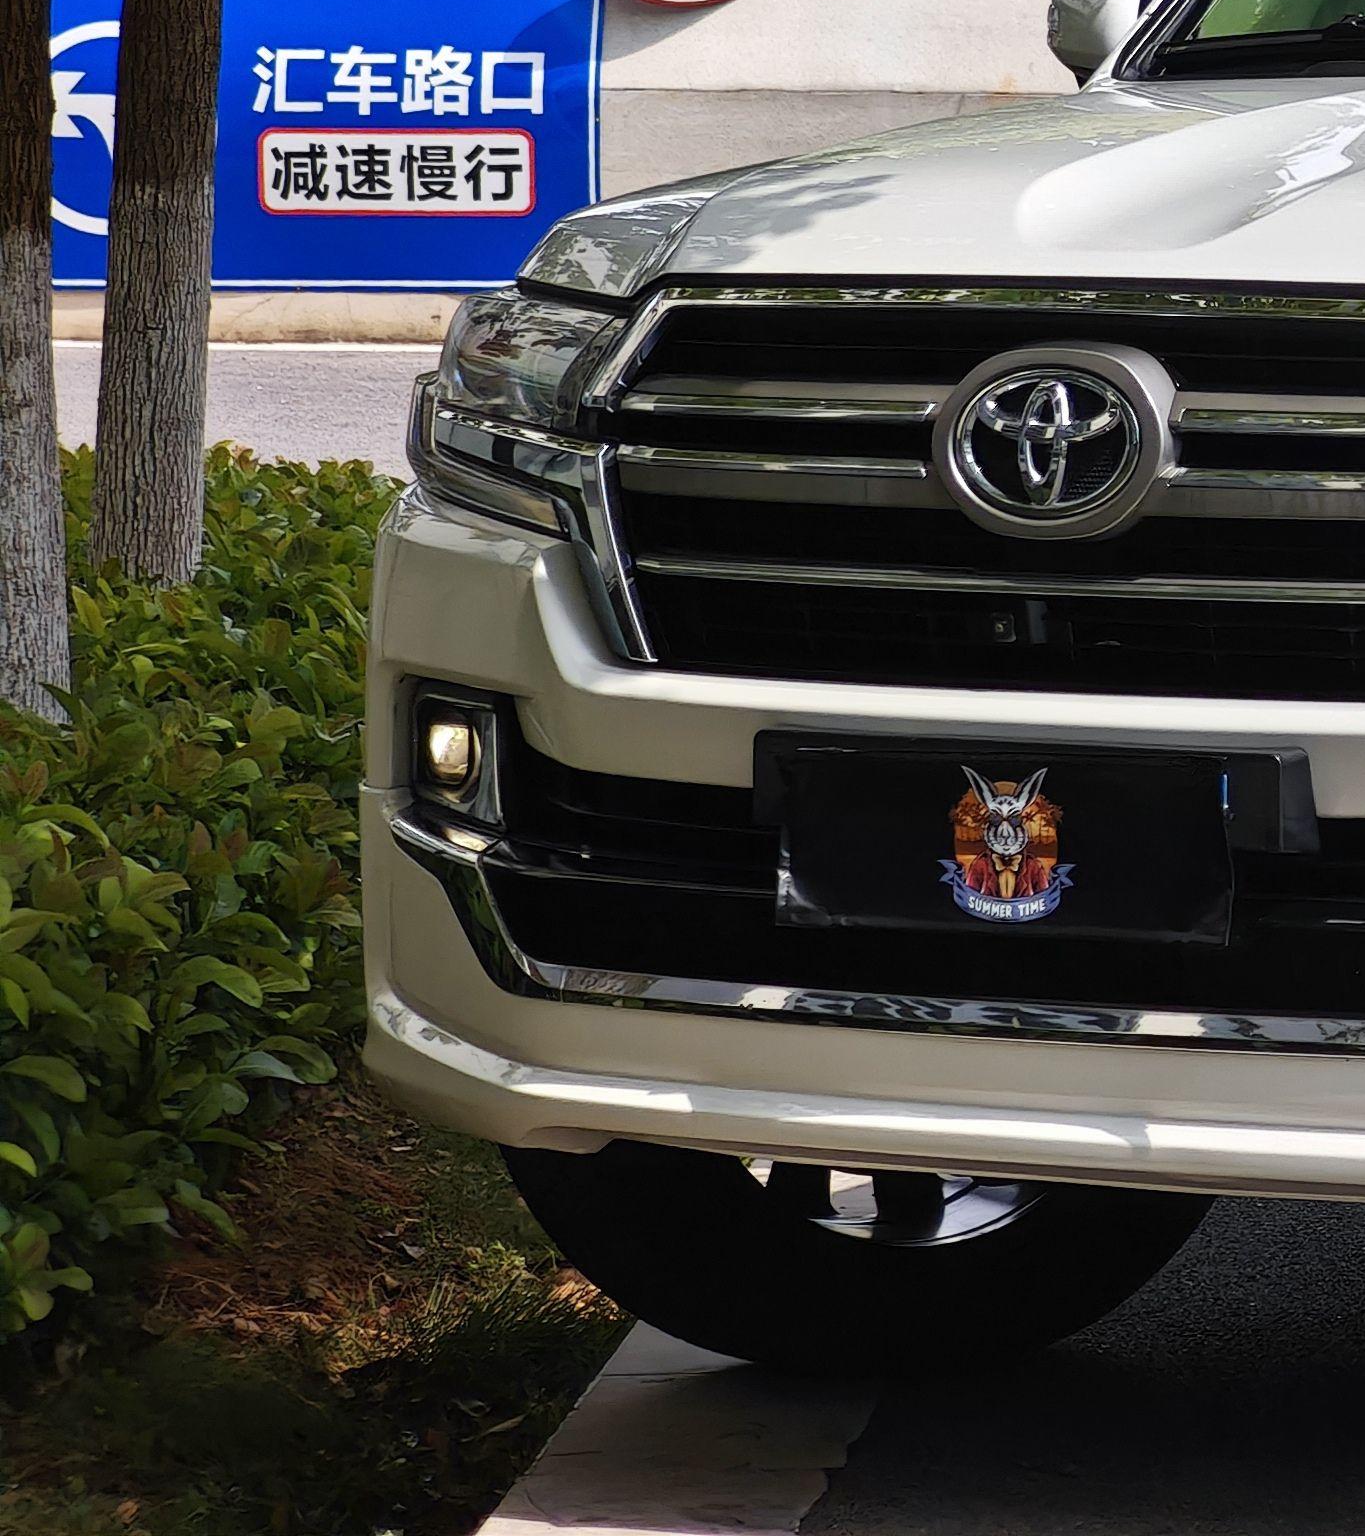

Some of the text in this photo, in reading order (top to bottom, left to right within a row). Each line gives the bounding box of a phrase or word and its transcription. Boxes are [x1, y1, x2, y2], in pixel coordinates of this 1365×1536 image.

[252, 45, 544, 115] 汇车路口
[271, 144, 523, 201] 减速慢行
[968, 897, 1046, 917] SUMMER TIME
